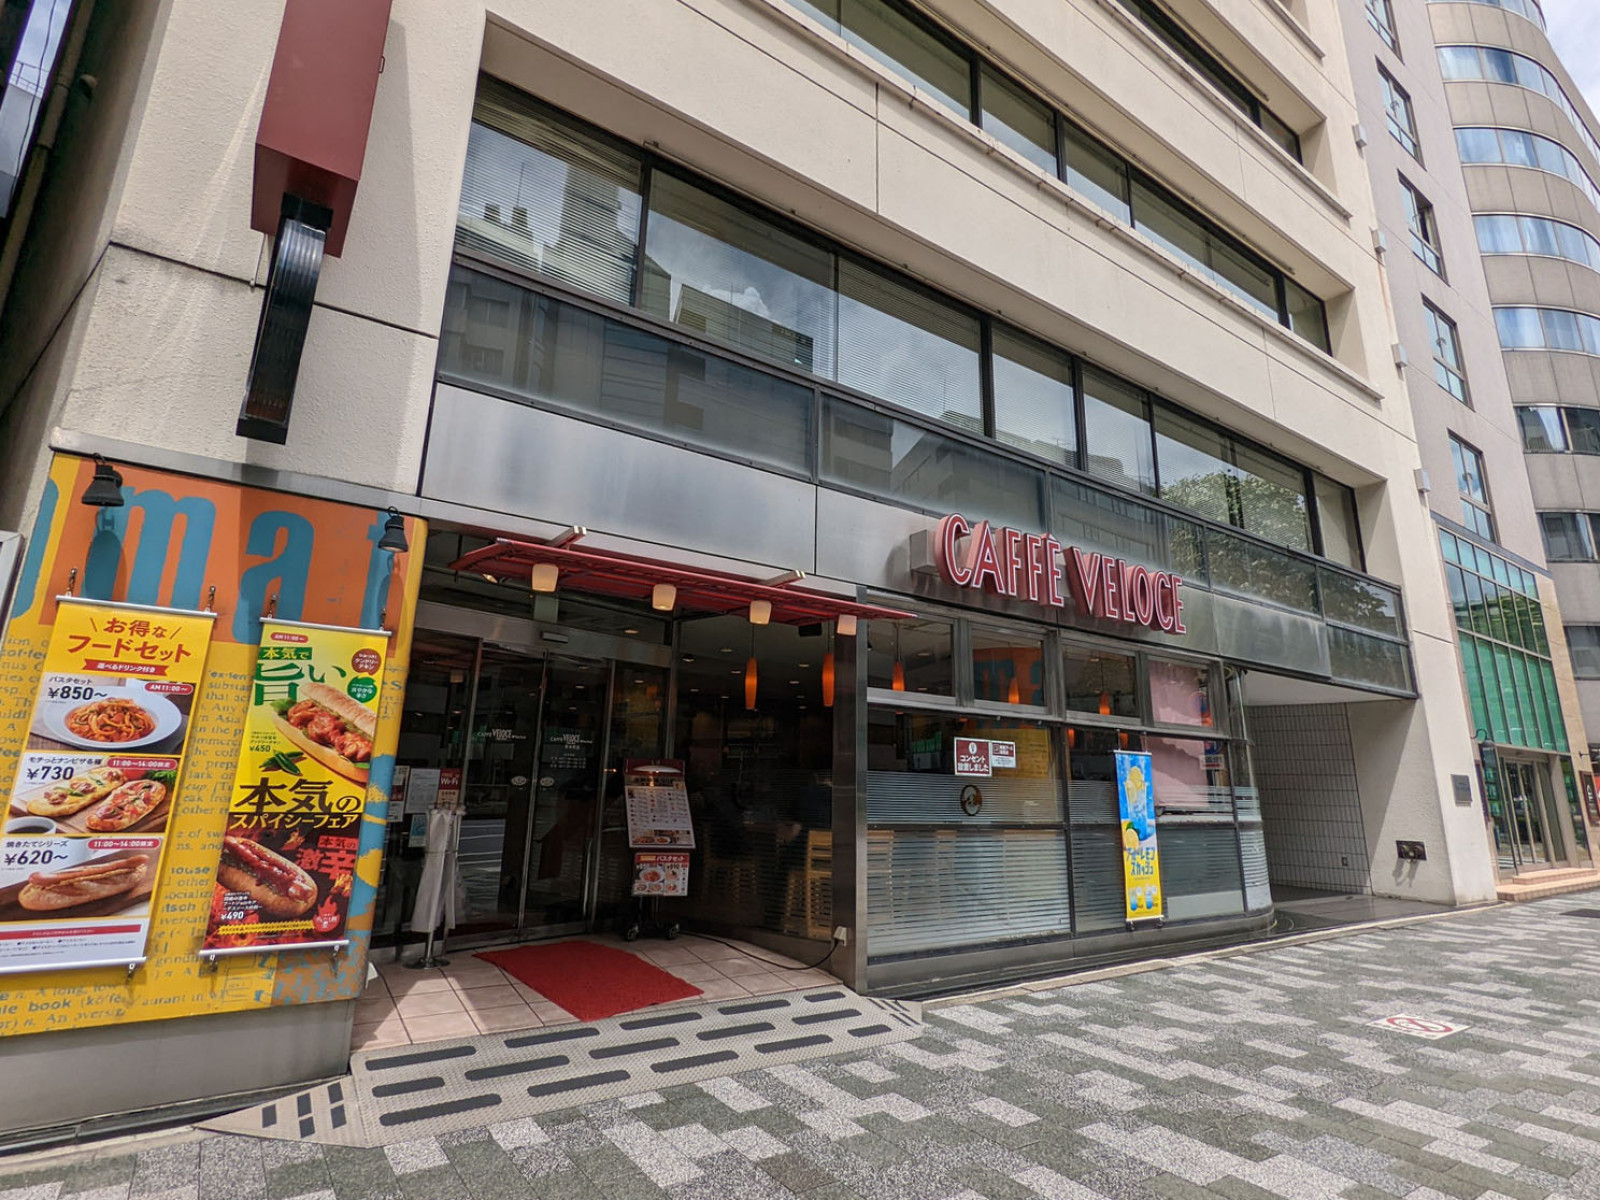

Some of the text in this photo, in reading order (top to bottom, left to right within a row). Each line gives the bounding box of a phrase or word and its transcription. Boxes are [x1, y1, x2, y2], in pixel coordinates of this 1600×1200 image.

[1064, 546, 1187, 635] VELOCE
[103, 618, 168, 638] お得な
[68, 634, 192, 663] フードセット
[262, 647, 310, 660] 本気で
[49, 676, 93, 686] パスタセット
[254, 661, 347, 706] 旨い
[27, 766, 74, 781] ¥730
[233, 777, 362, 814] 本気の
[229, 813, 359, 830] スパイシーフェア
